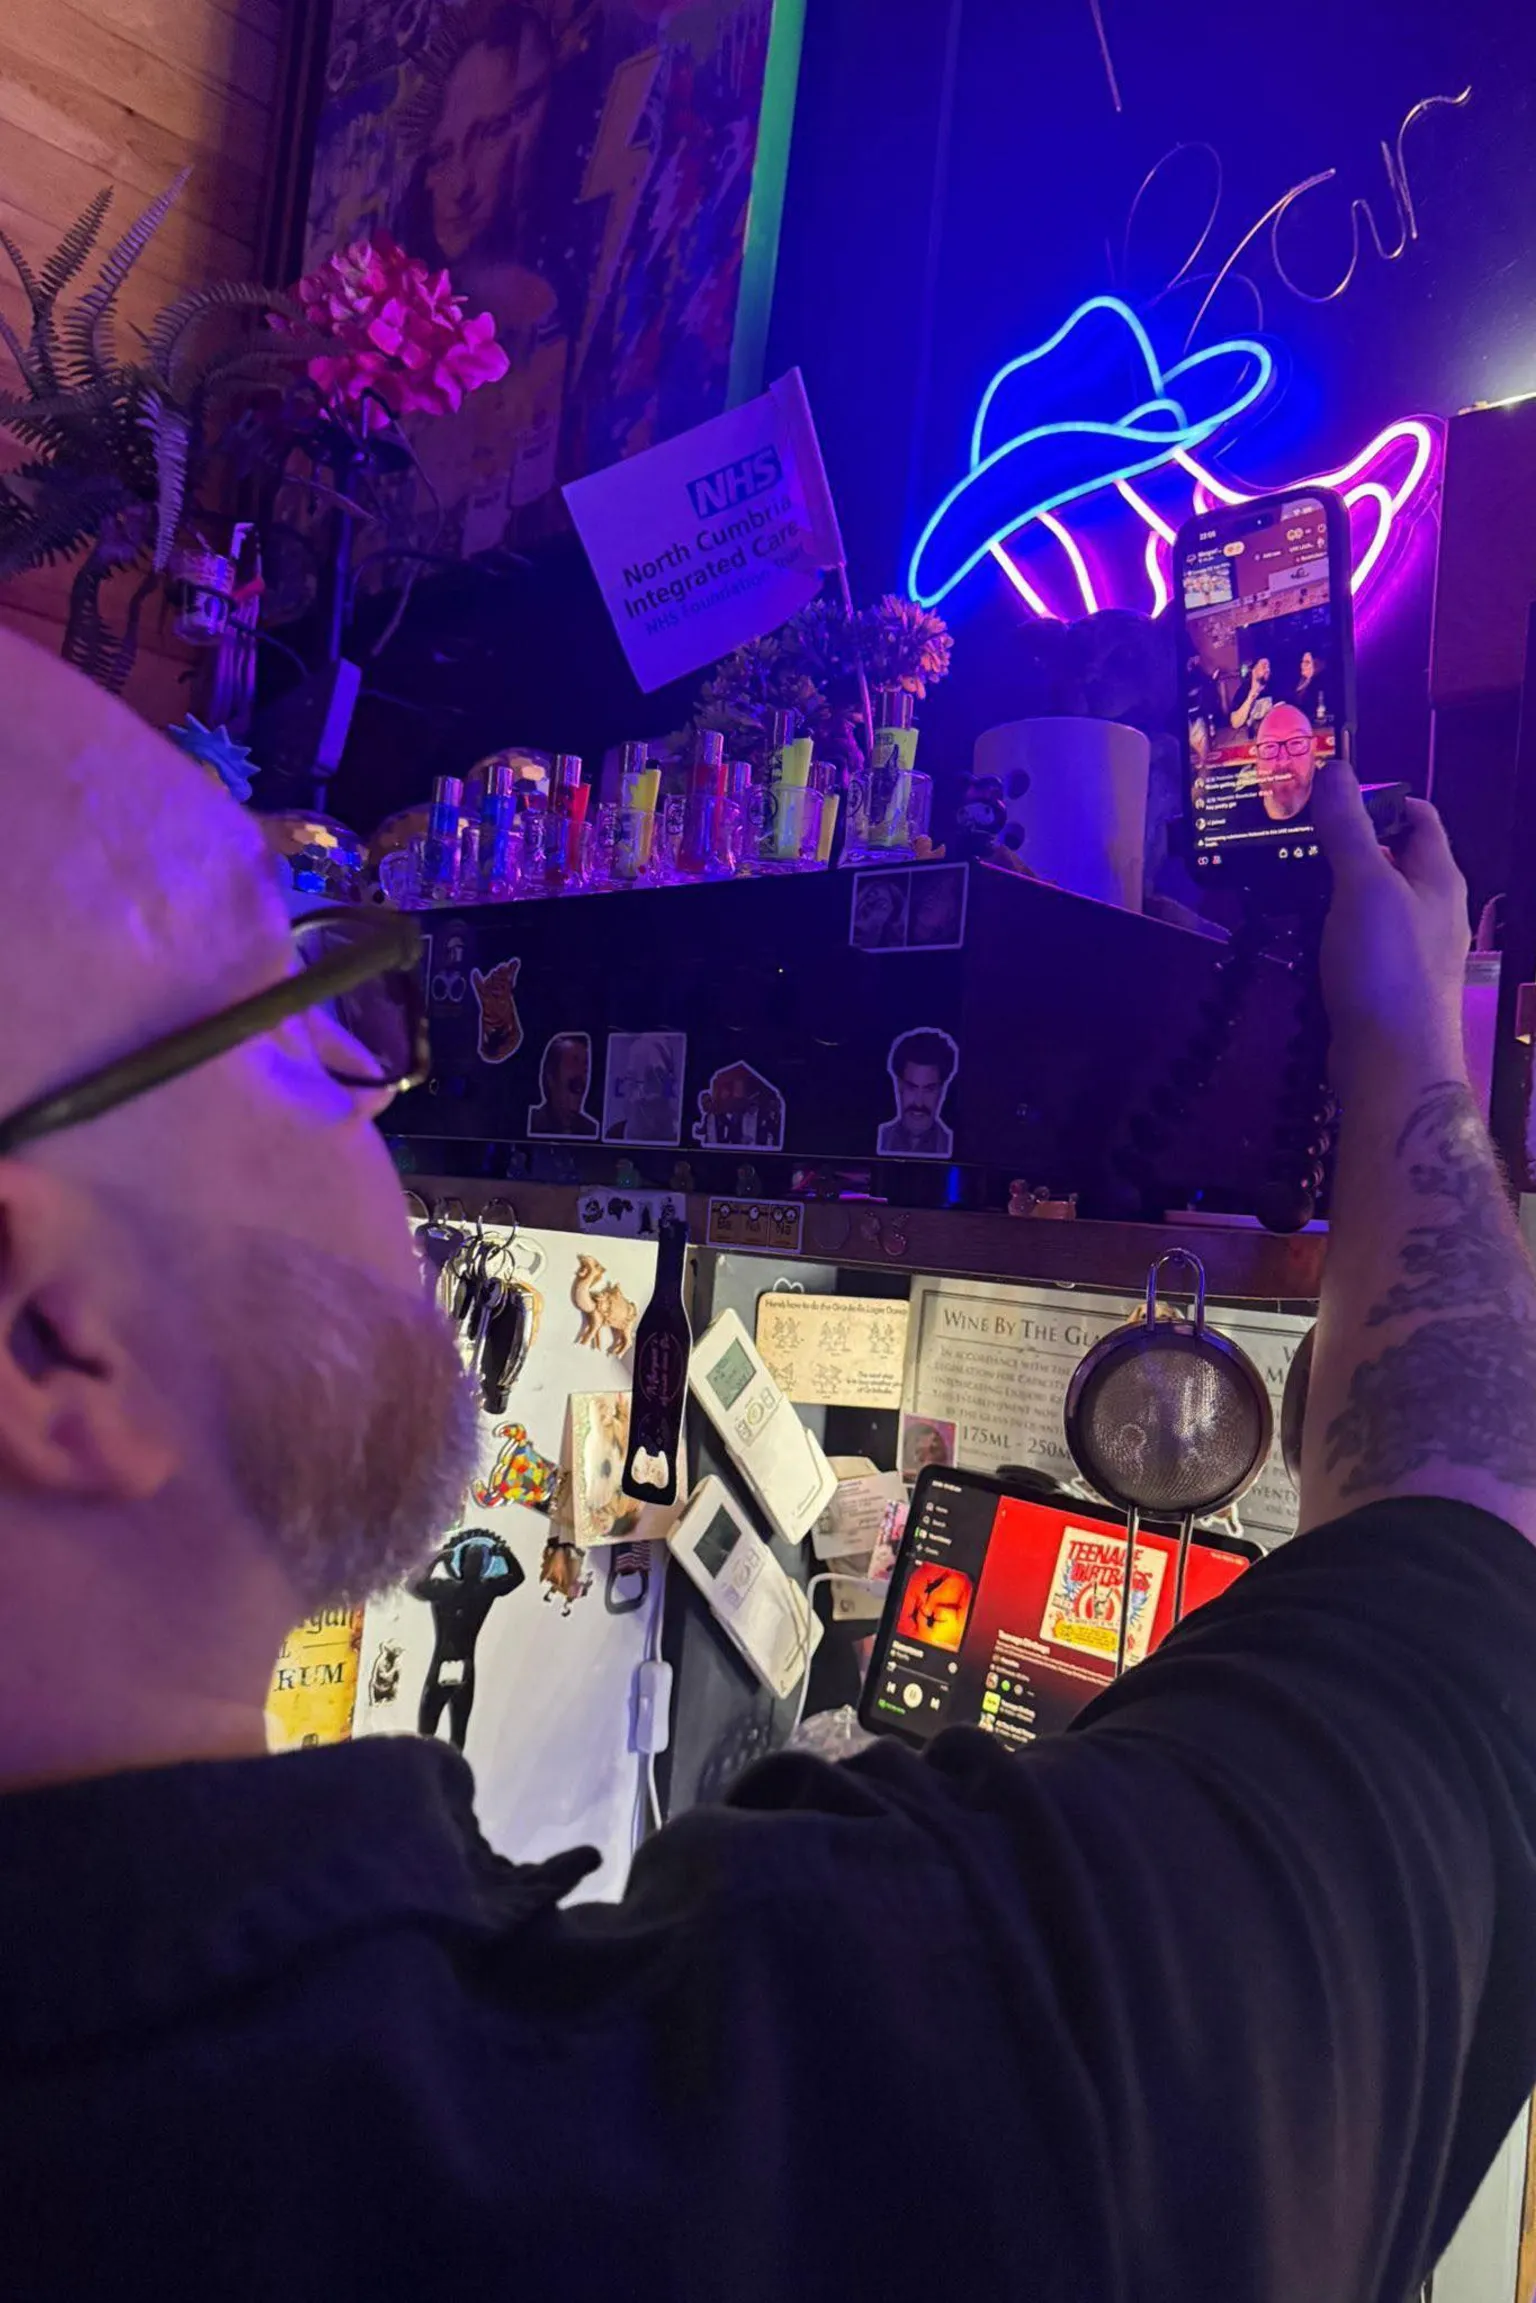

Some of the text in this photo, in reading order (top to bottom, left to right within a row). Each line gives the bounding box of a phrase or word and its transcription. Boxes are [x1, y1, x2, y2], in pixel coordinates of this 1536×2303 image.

[695, 450, 779, 516] NHS
[623, 495, 792, 587] North Cumbria
[624, 519, 801, 619] Integrated Care
[645, 612, 680, 635] NHS
[684, 568, 771, 617] Foundation
[943, 1308, 1101, 1349] WINE BY THE GLA
[963, 1426, 1012, 1449] 175ML
[1026, 1437, 1073, 1461] 250M
[1067, 1540, 1145, 1567] TEENAE
[1070, 1560, 1153, 1592] DIRTBGS
[273, 1660, 348, 1692] RUM
